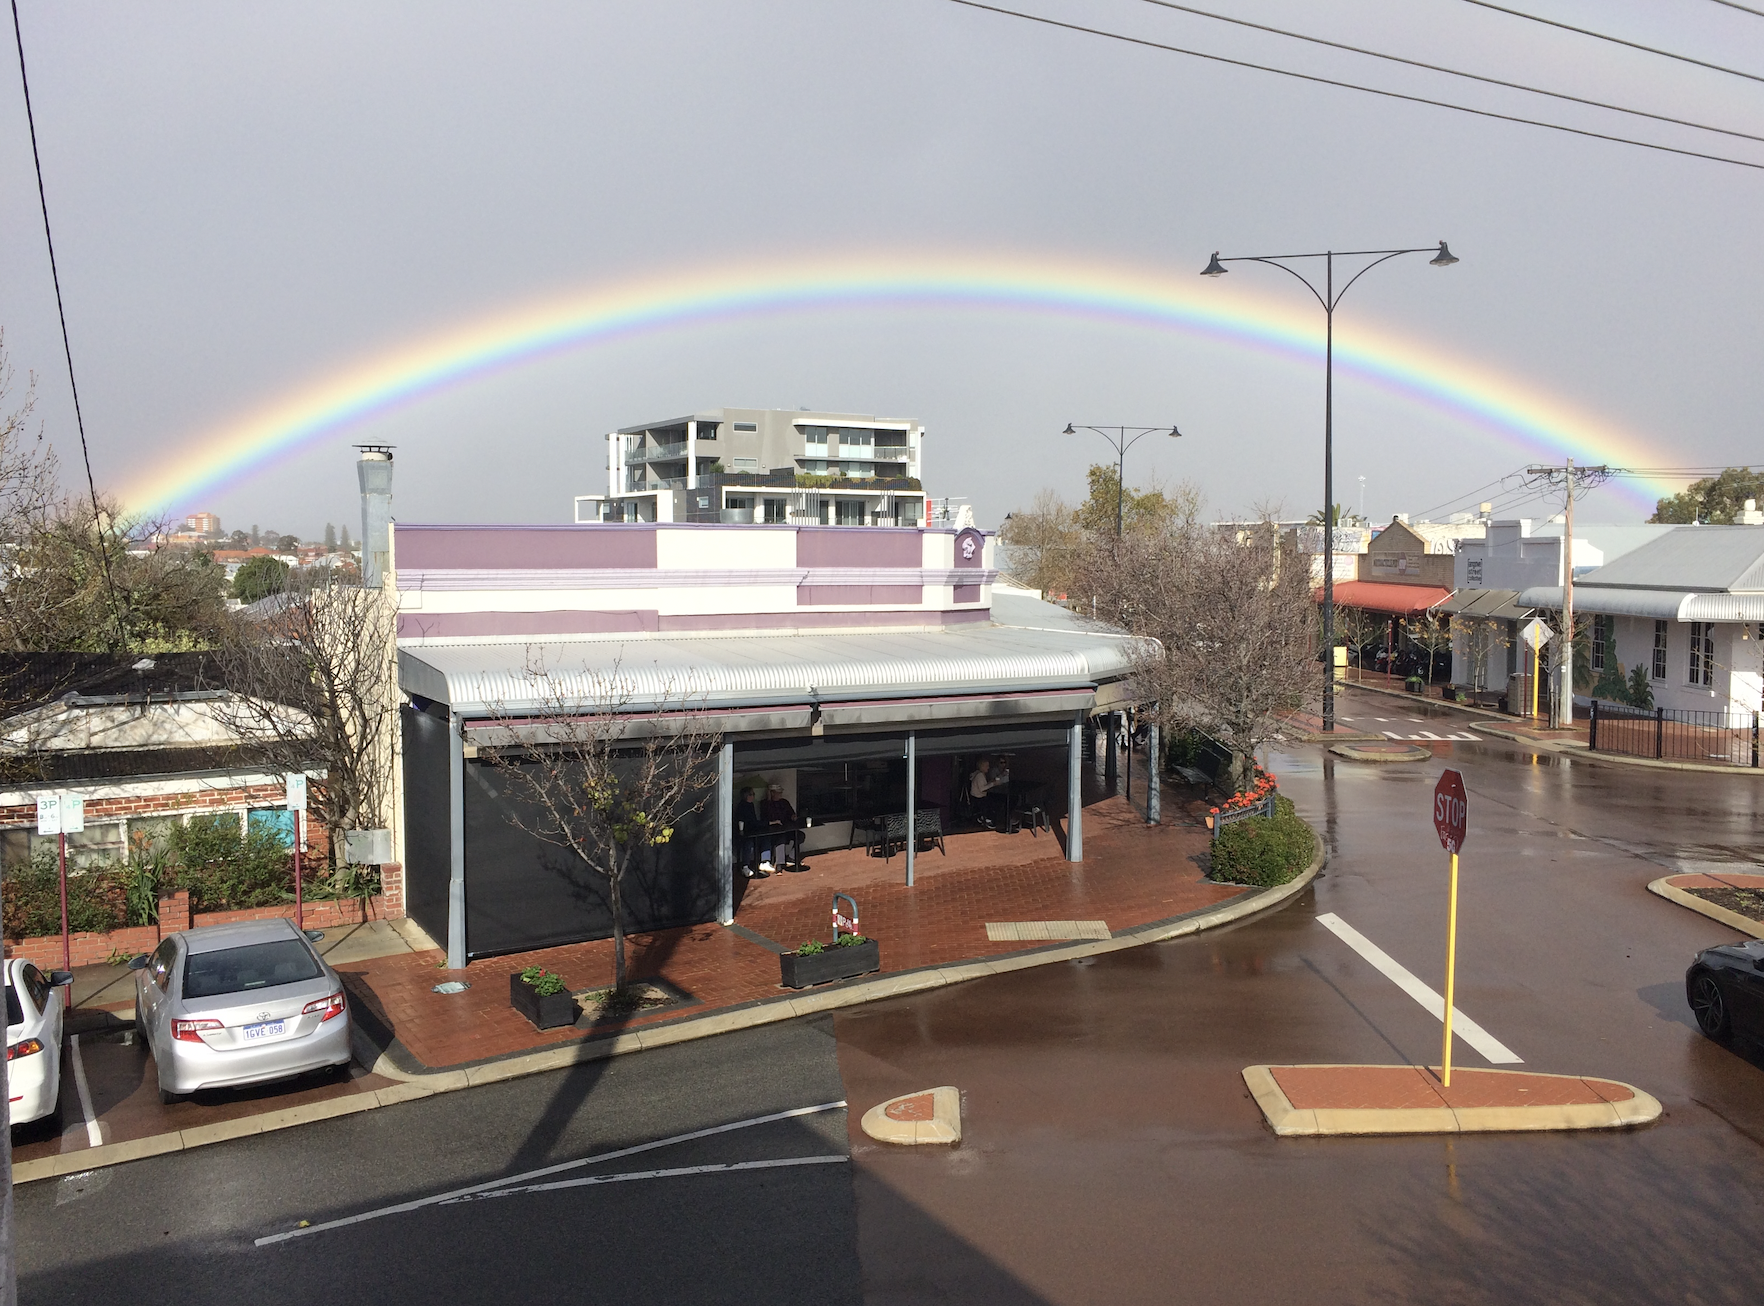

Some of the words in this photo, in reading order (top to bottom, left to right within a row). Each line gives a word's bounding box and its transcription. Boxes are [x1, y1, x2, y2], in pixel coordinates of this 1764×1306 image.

[40, 800, 58, 810] 3P
[1436, 792, 1465, 829] STOP
[246, 1027, 266, 1039] 1GVE
[269, 1024, 283, 1035] 058
